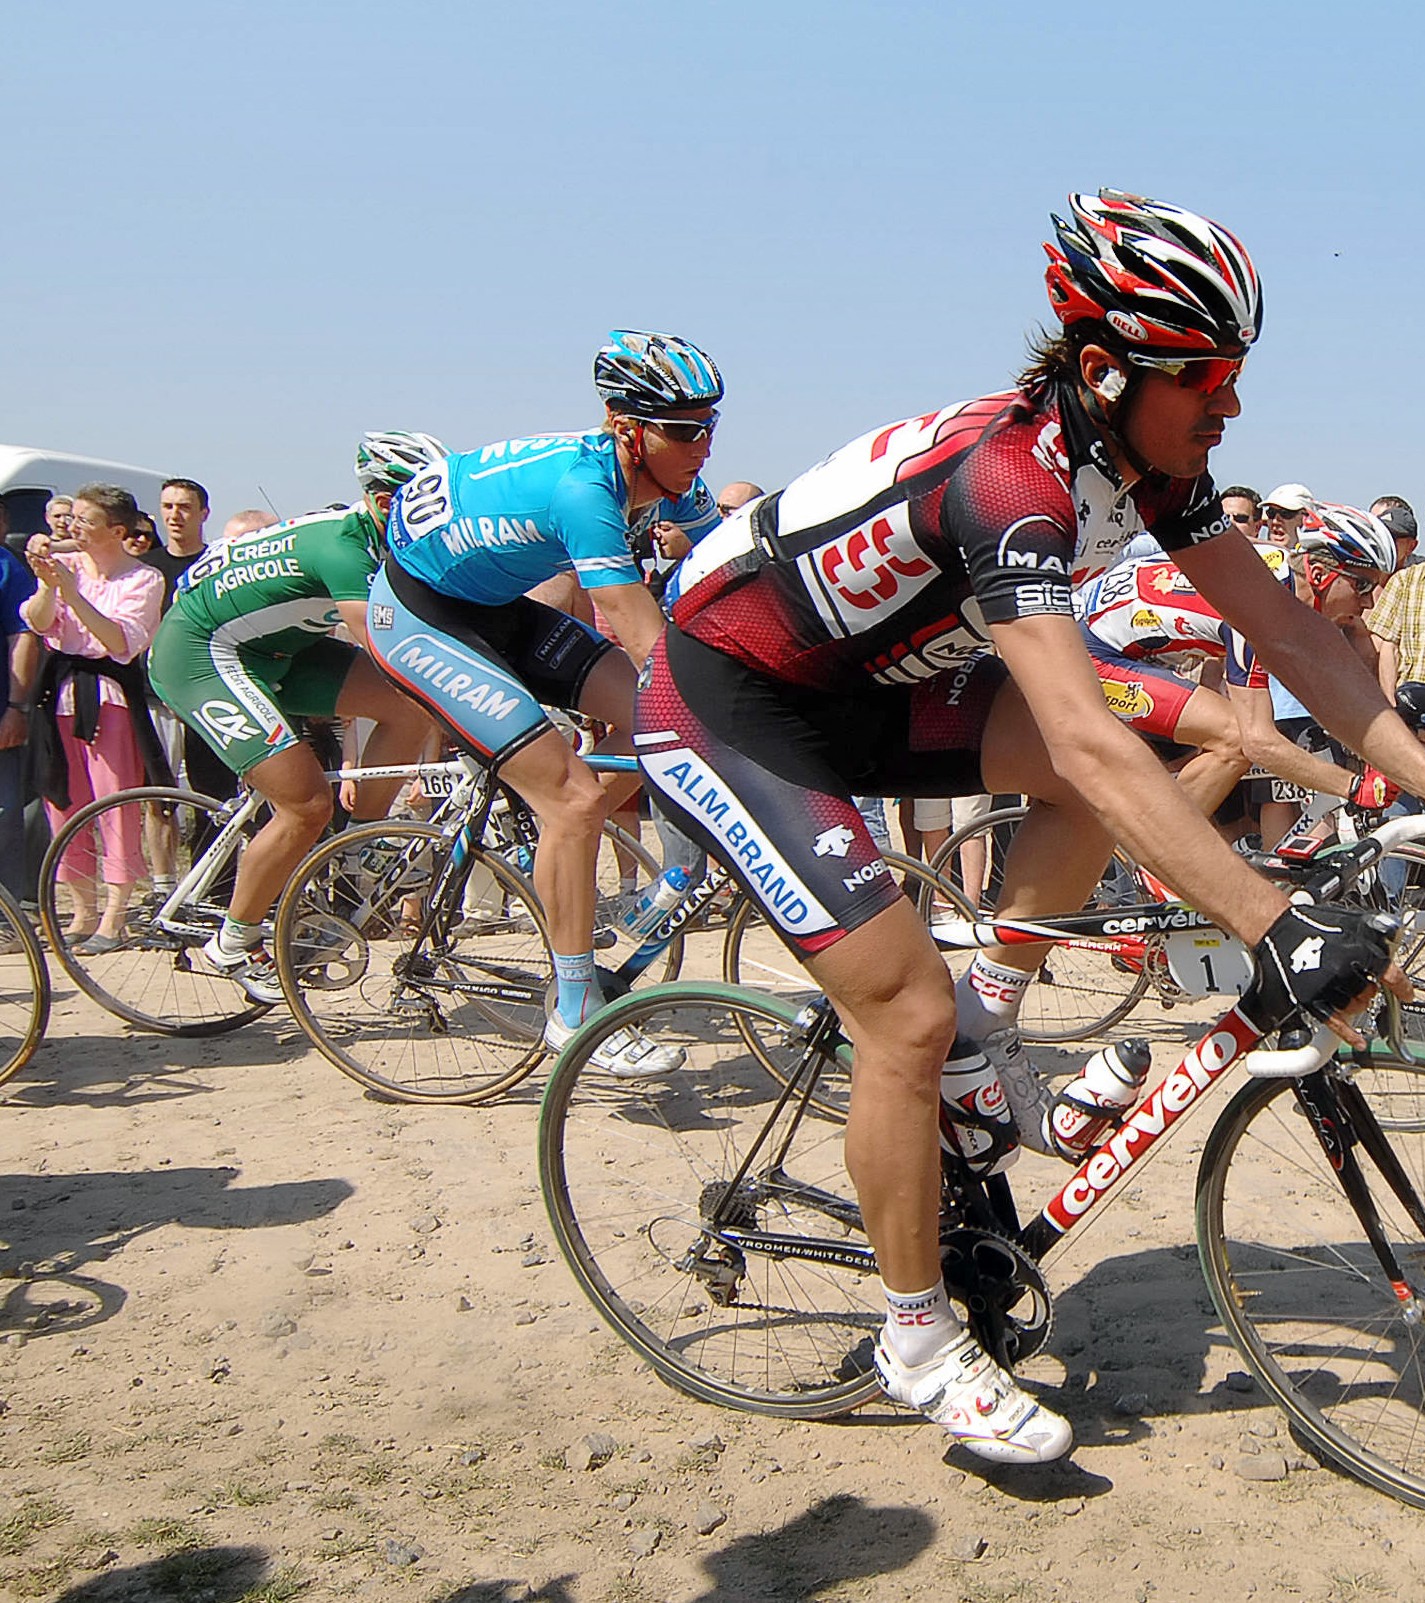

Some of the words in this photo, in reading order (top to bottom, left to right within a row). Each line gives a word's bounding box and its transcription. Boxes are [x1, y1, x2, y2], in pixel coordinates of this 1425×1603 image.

[1111, 315, 1141, 341] BELL
[404, 474, 449, 525] 90
[440, 516, 546, 557] MILRAM
[1189, 517, 1233, 544] NOB
[231, 534, 297, 563] CRÉDIT
[213, 558, 304, 599] AGRICOLE
[400, 645, 521, 721] MILRAM
[422, 775, 453, 796] 166
[662, 760, 810, 926] ALM.BRAND
[841, 859, 888, 894] NOB
[967, 973, 1018, 1004] CSC
[974, 961, 1031, 987] DESCENT
[1199, 954, 1220, 993] 1
